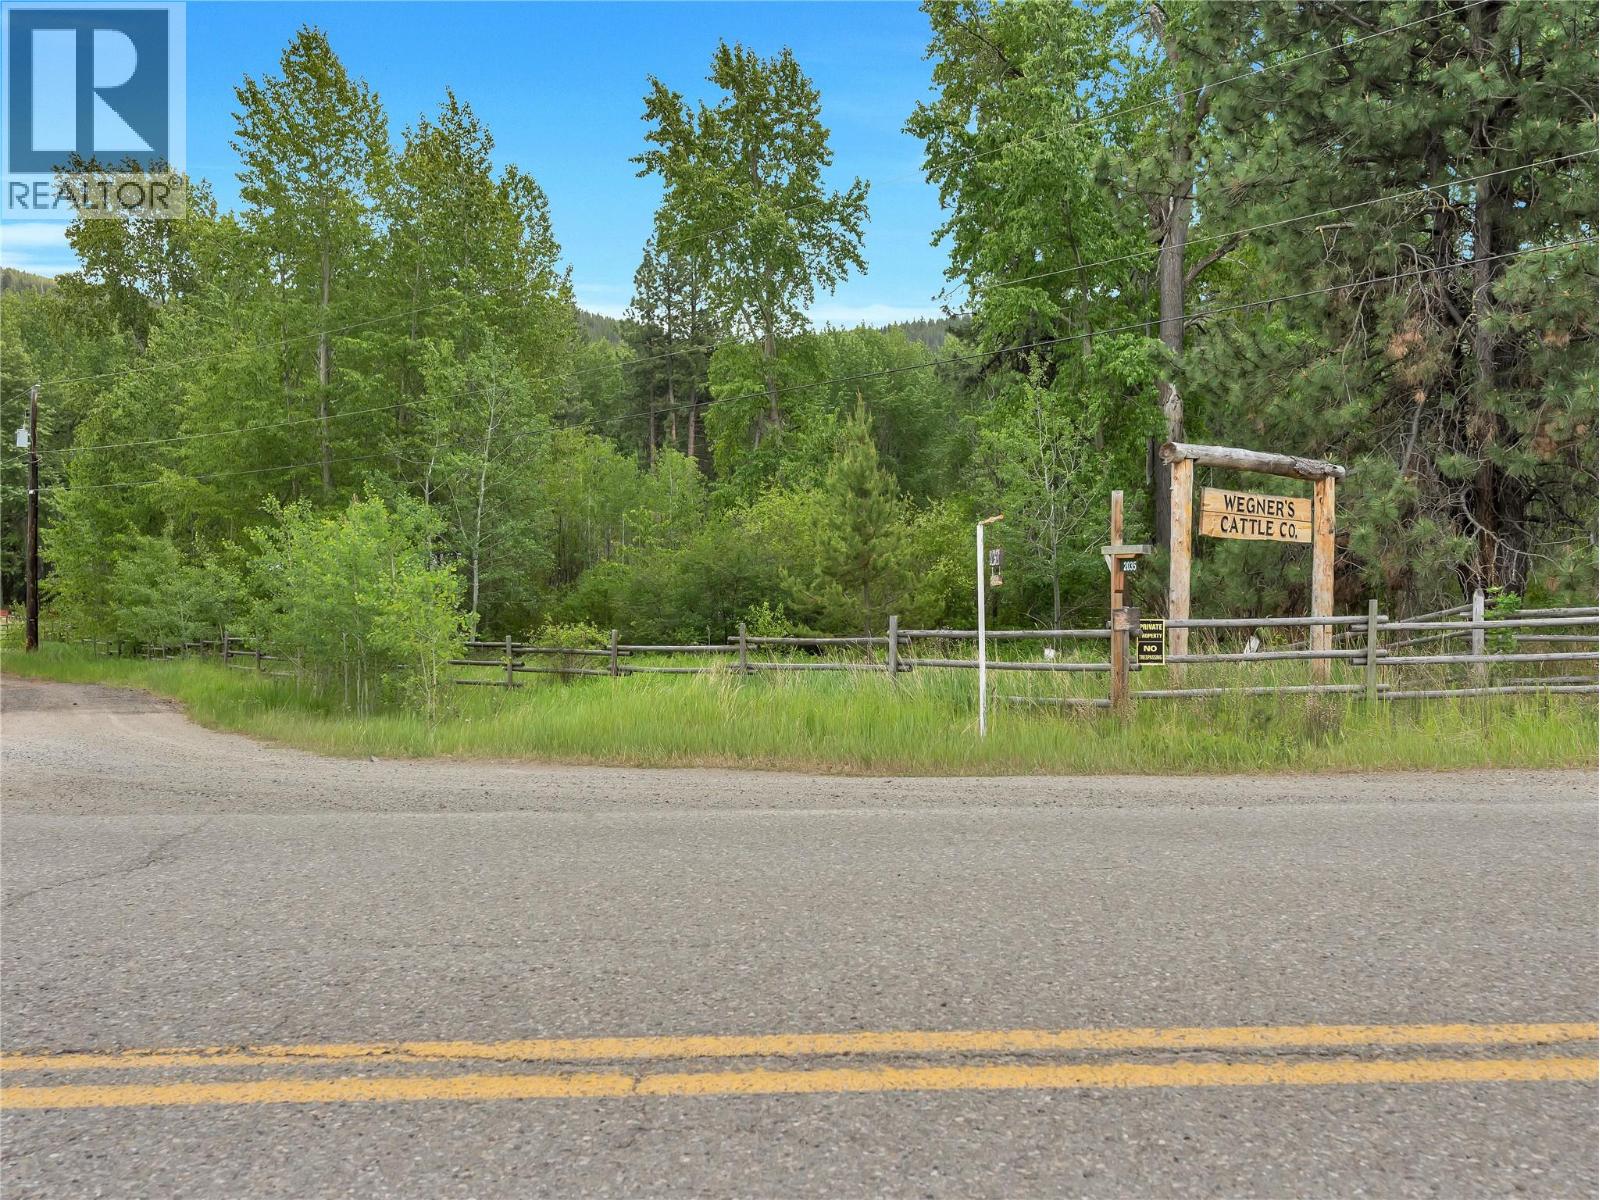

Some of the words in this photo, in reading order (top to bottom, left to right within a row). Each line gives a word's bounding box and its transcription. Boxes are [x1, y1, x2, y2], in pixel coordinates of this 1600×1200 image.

[1224, 494, 1295, 518] WEGNER'S
[1220, 515, 1274, 537] CATTLE
[1280, 521, 1298, 539] CO.
